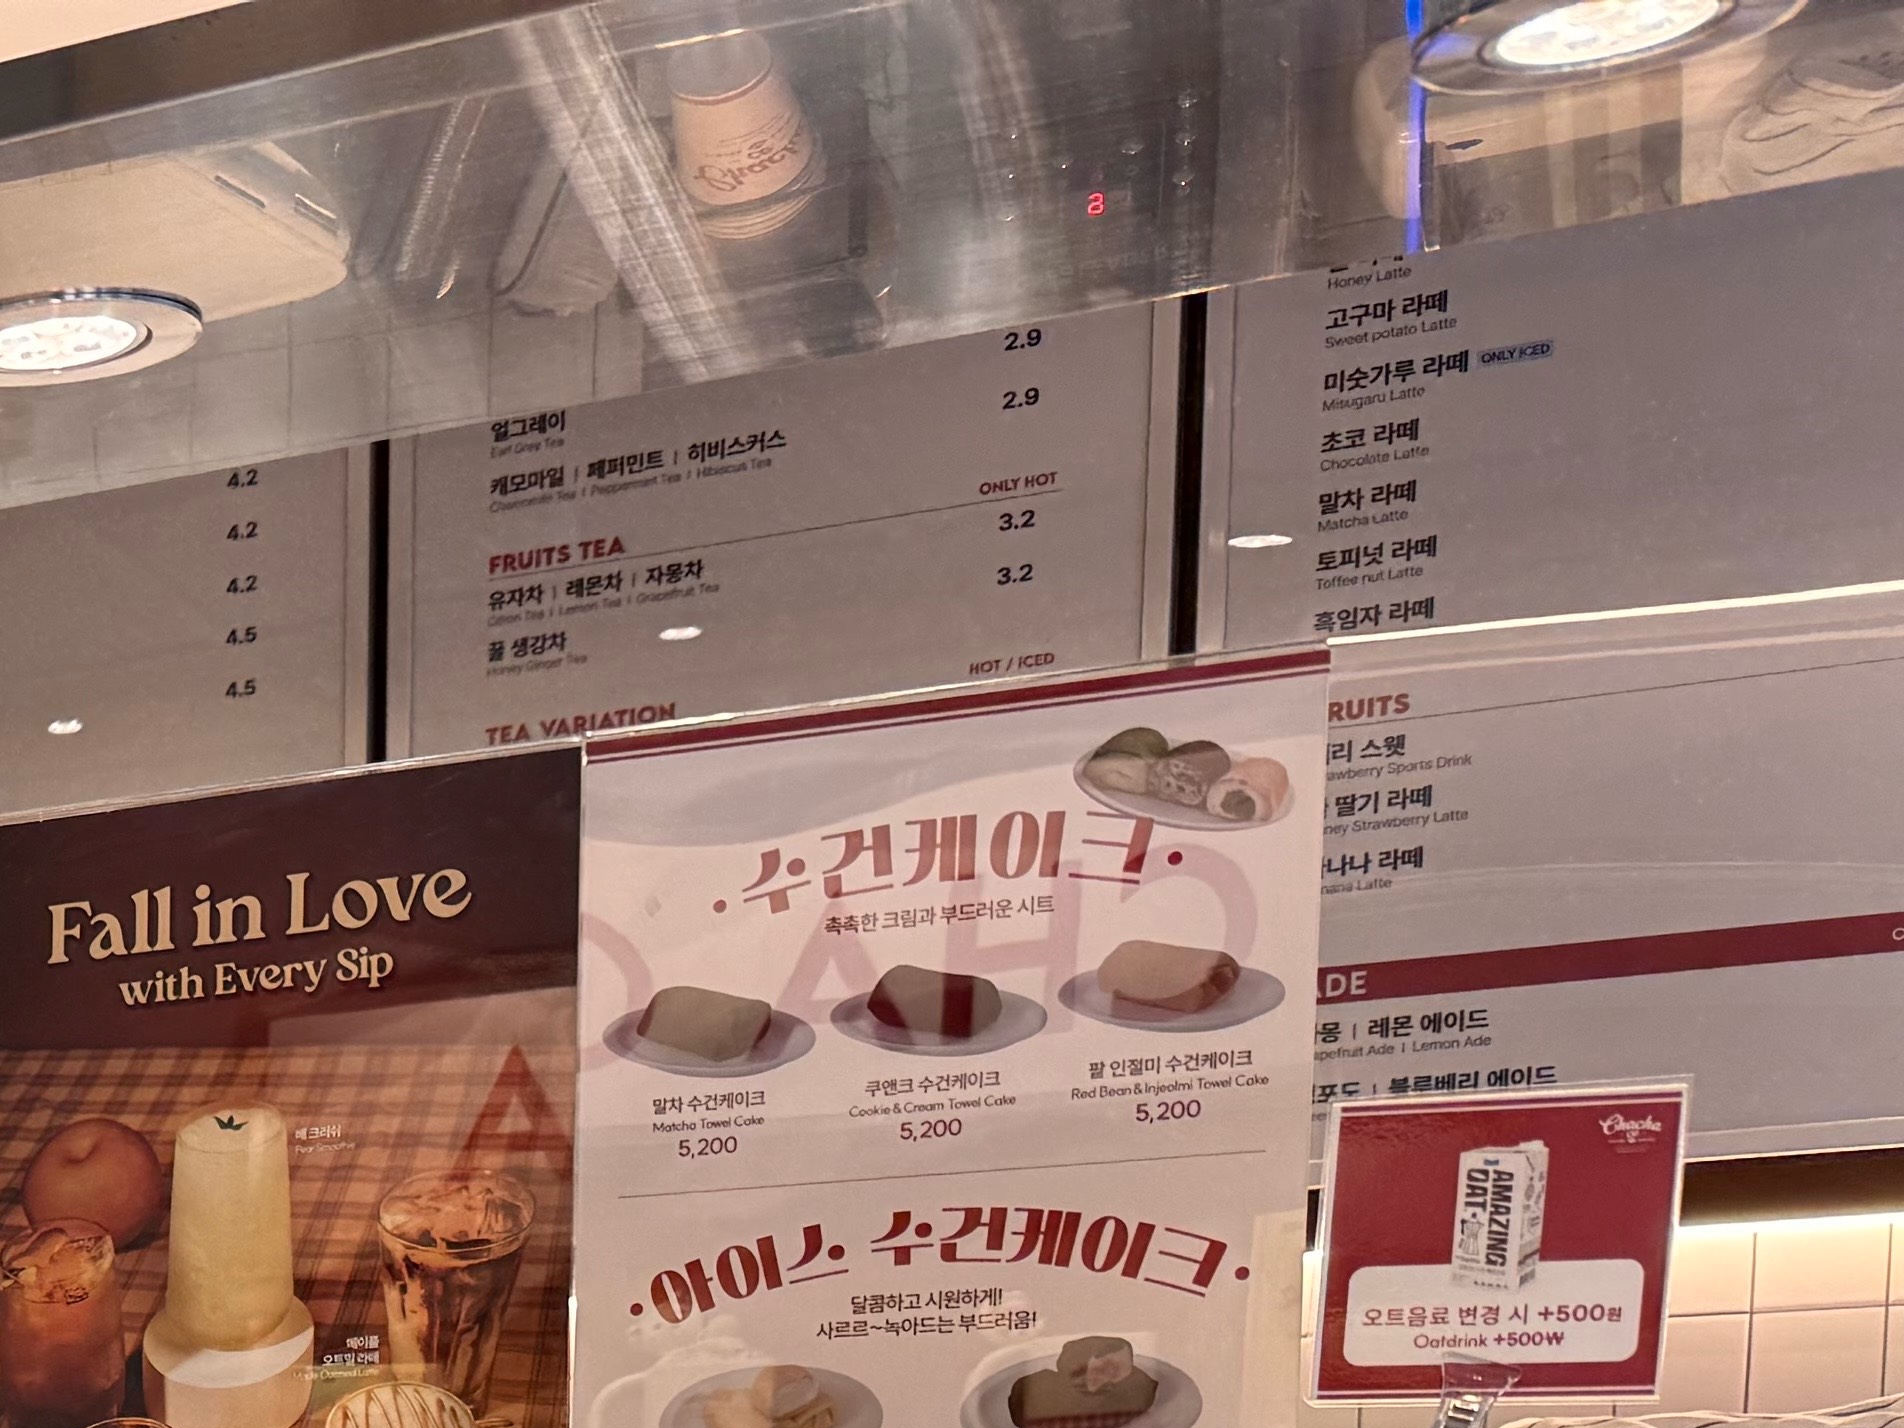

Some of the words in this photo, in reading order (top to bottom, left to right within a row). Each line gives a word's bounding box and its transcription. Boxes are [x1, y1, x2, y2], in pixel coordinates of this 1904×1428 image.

[1325, 301, 1395, 331] 고구마
[1402, 290, 1448, 315] 라떼
[1004, 328, 1041, 351] 2.9
[1324, 359, 1415, 393] 미숫가루
[1423, 350, 1469, 374] 라떼
[1002, 387, 1040, 410] 2.9
[491, 410, 565, 442] 얼그레이
[1320, 427, 1366, 453] 초코
[1374, 419, 1419, 444] 라떼
[688, 430, 787, 462] 히비스커스
[227, 470, 258, 488] 4.2
[979, 478, 1020, 495] ONLY
[1025, 471, 1057, 488] HOT
[1319, 488, 1363, 515] 말차
[1371, 480, 1417, 504] 라떼
[227, 523, 258, 542] 4.2
[998, 510, 1036, 531] 3.2
[489, 544, 570, 575] FRUITS
[578, 537, 626, 559] TEA
[1316, 543, 1383, 572] 토피넛
[1391, 535, 1437, 560] 라떼
[227, 575, 258, 595] 4.2
[565, 572, 623, 598] 레몬차
[645, 559, 703, 586] 자몽차
[997, 564, 1033, 586] 3.2
[1314, 604, 1381, 632] 흑임자
[1389, 597, 1434, 621] 라떼
[225, 627, 257, 646] 4.5
[225, 679, 256, 699] 4.5
[486, 726, 529, 746] TEA
[540, 703, 676, 737] VARIATION
[1335, 791, 1379, 817] 딸기
[1387, 785, 1432, 810] 라떼
[743, 810, 1155, 914] 수건케이크
[1378, 846, 1424, 871] 라떼
[47, 885, 176, 965] Fall
[192, 883, 266, 948] in
[285, 867, 472, 937] Love
[823, 914, 879, 936] 촉촉한
[882, 906, 936, 929] 크림과
[939, 900, 1013, 926] 부드러운
[1017, 896, 1055, 917] 시트
[119, 966, 205, 1007] with
[214, 957, 328, 998] Every
[336, 946, 395, 988] Sip
[1368, 1014, 1413, 1039] 레몬
[1420, 1009, 1489, 1034] 에이드
[1136, 1100, 1202, 1124] 5,200
[900, 1118, 962, 1142] 5,200
[678, 1135, 738, 1159] 5,200
[1485, 1168, 1514, 1268] AMAZING
[650, 1222, 849, 1325] 아이스
[872, 1206, 1228, 1298] 수건케이크
[850, 1291, 923, 1316] 달콤하고
[926, 1287, 1004, 1312] 시원하게!
[1362, 1307, 1451, 1328] 오트음료
[1458, 1306, 1500, 1326] 변경
[1508, 1304, 1529, 1325] 시
